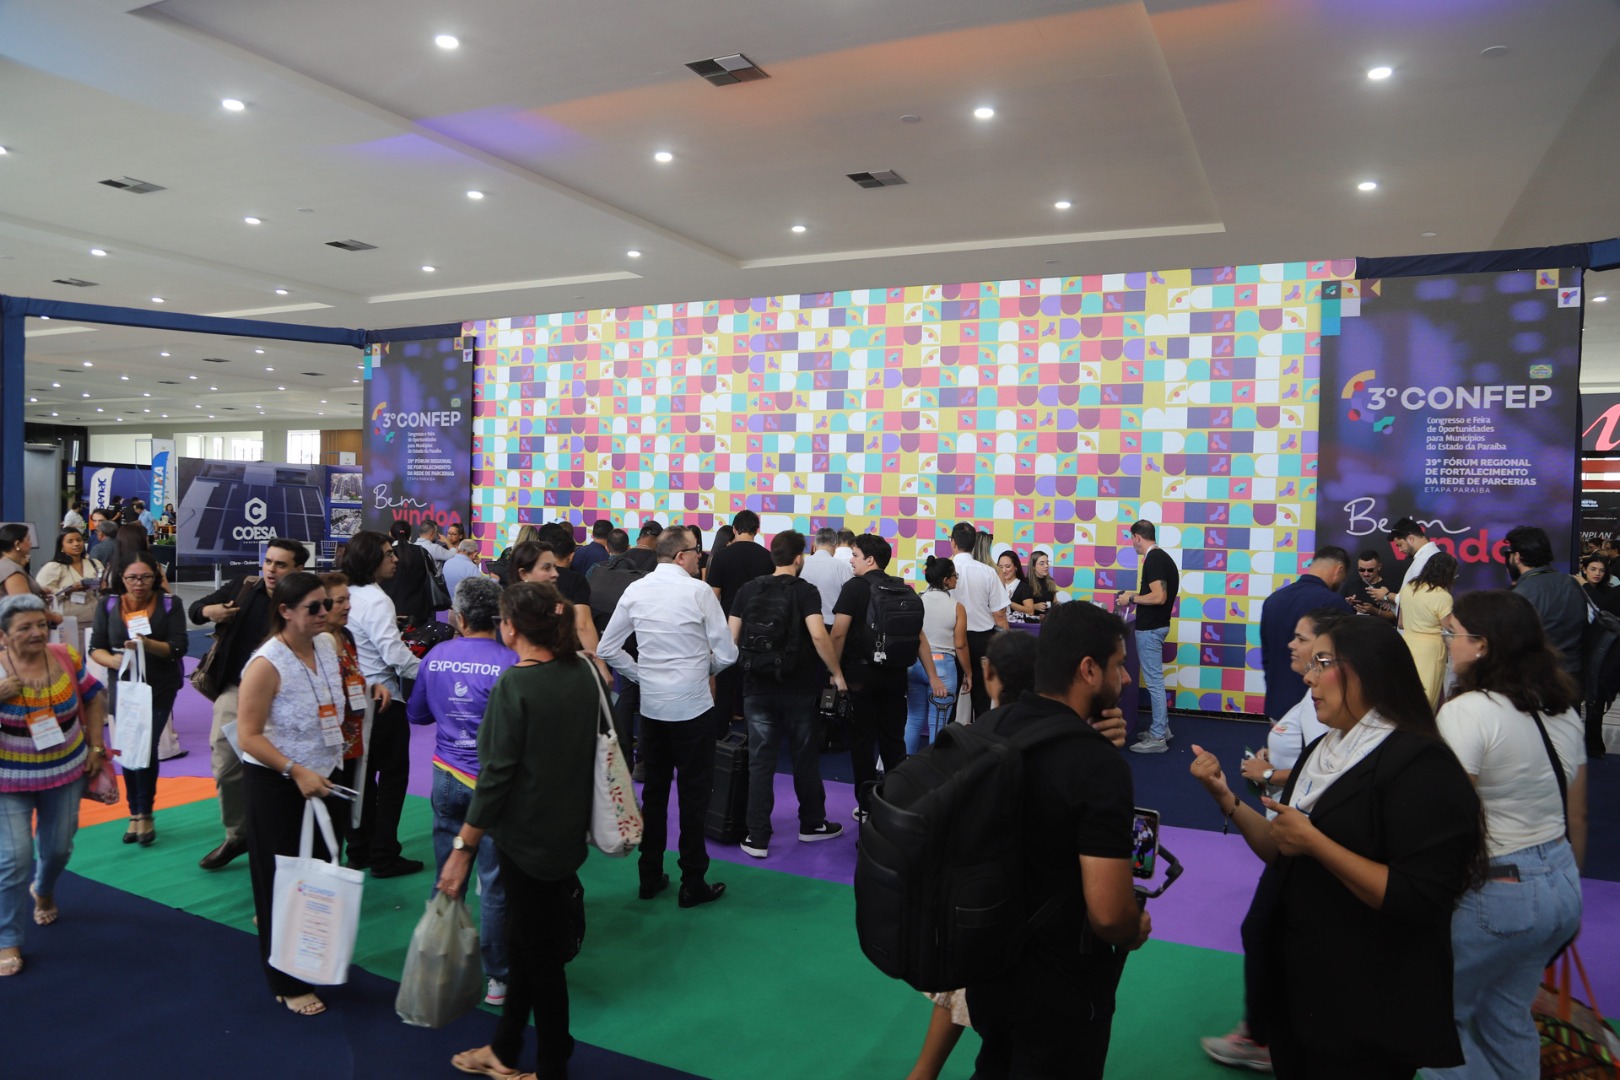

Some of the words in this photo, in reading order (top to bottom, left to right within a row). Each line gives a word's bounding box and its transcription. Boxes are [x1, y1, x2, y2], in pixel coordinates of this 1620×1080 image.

[1400, 385, 1553, 411] CONFEP
[396, 411, 461, 428] CONFEP
[1426, 416, 1465, 425] Congresso
[1473, 416, 1491, 424] Feira
[1426, 425, 1437, 433] de
[1438, 425, 1495, 434] Oportunidades
[1426, 435, 1444, 443] para
[1445, 433, 1486, 444] Municípios
[1426, 443, 1437, 451] do
[1438, 443, 1464, 451] Estado
[1465, 443, 1476, 451] da
[1477, 442, 1507, 451] Paraíba
[1443, 457, 1479, 467] FÓRUM
[1480, 458, 1532, 467] REGIONAL
[1425, 468, 1438, 476] DE
[1440, 468, 1529, 477] FORTALECIMENTO
[153, 466, 164, 506] CAIXA
[1425, 477, 1439, 485] DA
[1440, 477, 1465, 485] REDE
[1466, 478, 1480, 486] DE
[1481, 478, 1537, 486] PARCERIAS
[1453, 486, 1491, 494] PARAÍBA
[373, 483, 428, 509] Bem
[232, 526, 278, 541] COESA
[1579, 531, 1612, 539] NPLAN
[428, 660, 501, 677] EXPOSITOR
